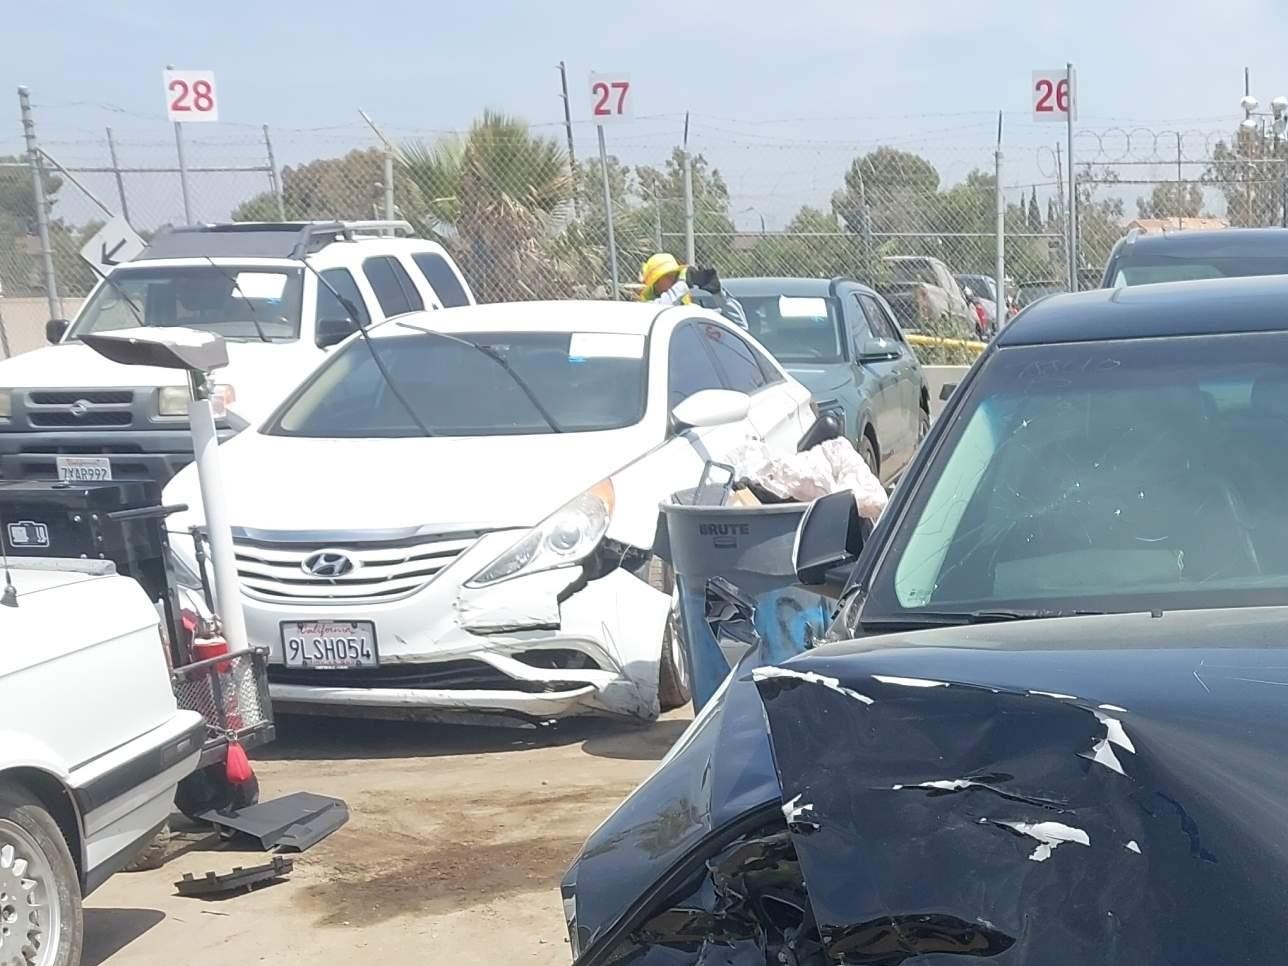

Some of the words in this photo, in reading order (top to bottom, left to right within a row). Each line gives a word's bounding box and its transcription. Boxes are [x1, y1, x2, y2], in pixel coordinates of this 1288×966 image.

[168, 80, 214, 112] 28
[592, 82, 629, 115] 27
[1035, 79, 1069, 112] 26
[700, 523, 749, 535] BRUTE
[300, 623, 355, 637] California
[289, 639, 371, 661] 9LSH054
